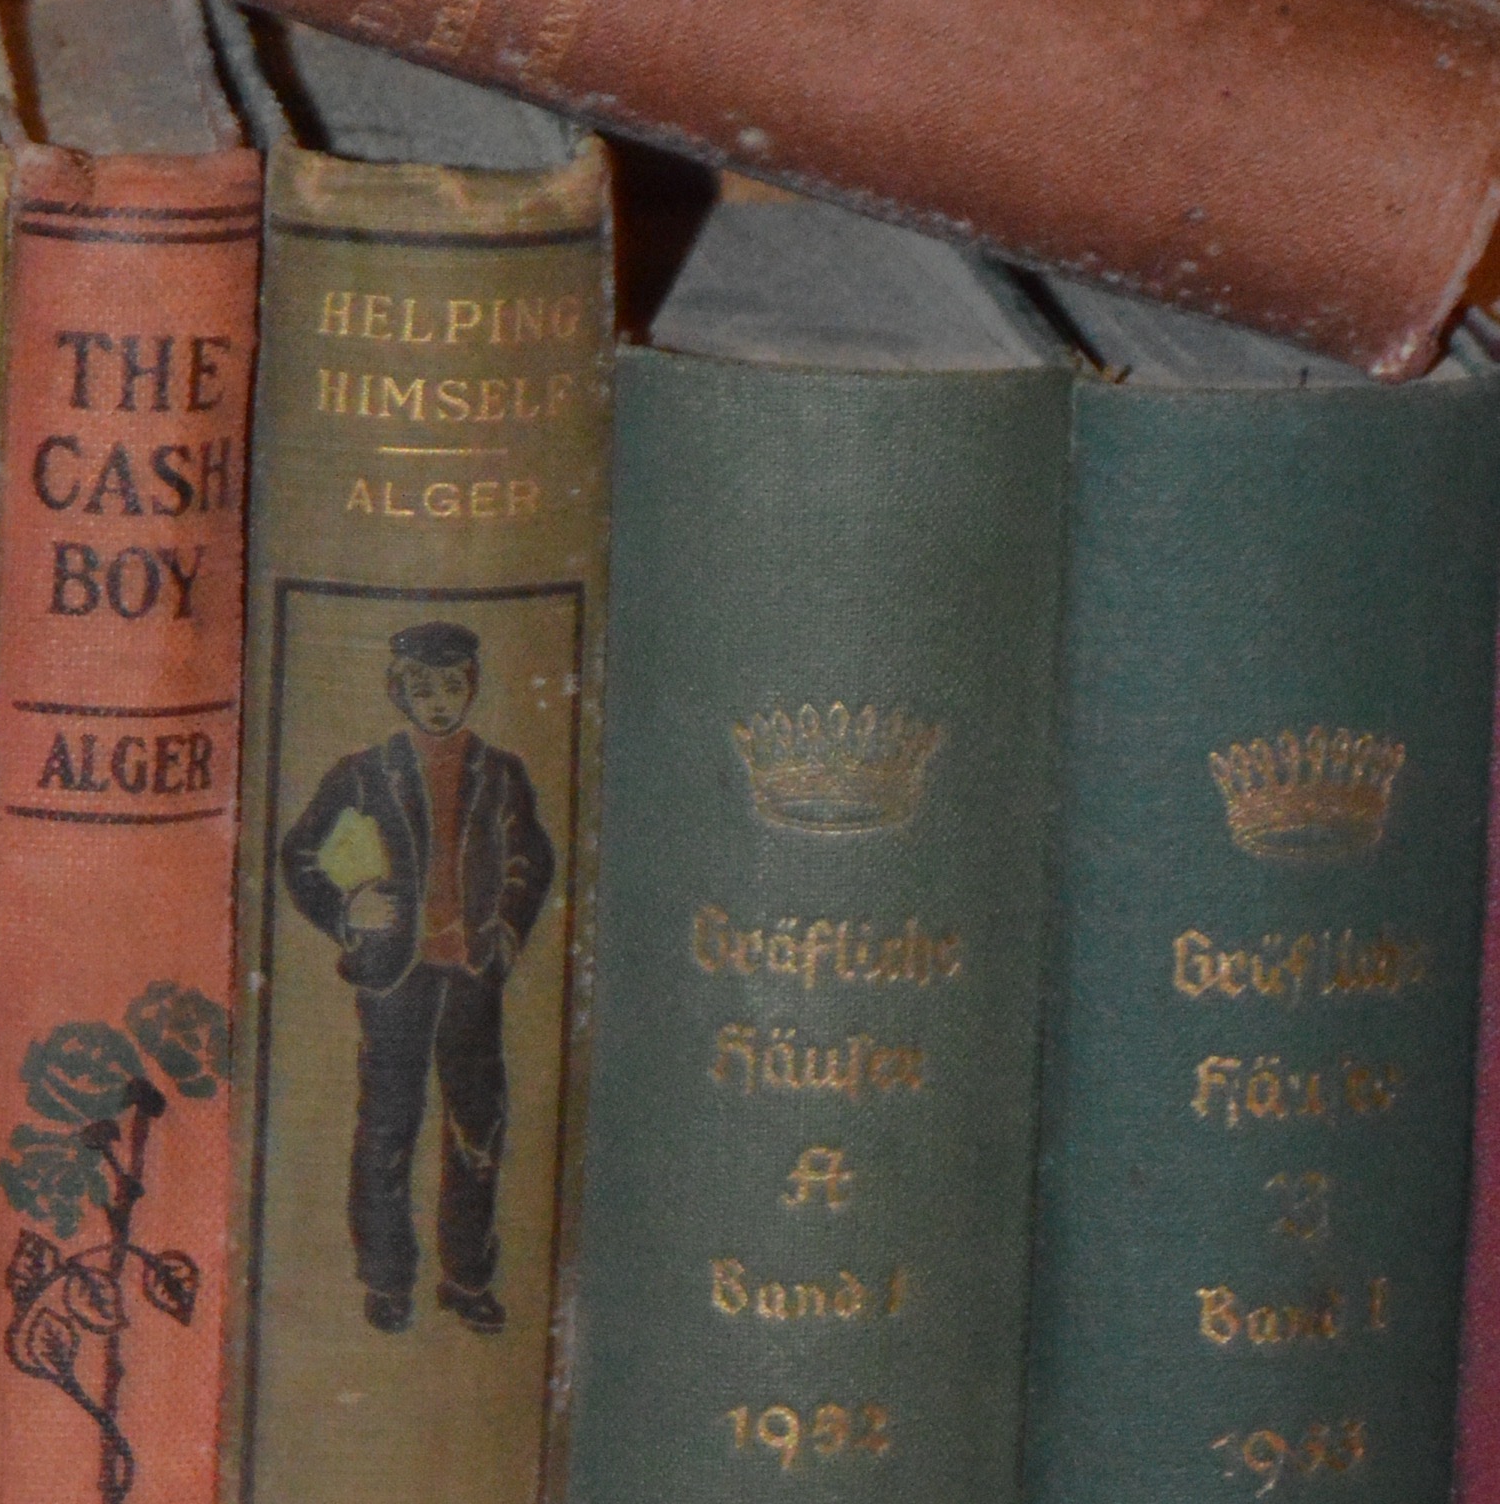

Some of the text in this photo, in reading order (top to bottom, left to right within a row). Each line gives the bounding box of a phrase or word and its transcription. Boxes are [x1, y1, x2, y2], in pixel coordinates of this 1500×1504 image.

[317, 289, 585, 347] HELPING
[55, 330, 233, 414] THE
[317, 367, 579, 425] HIMSELF
[31, 435, 234, 518] CASH
[344, 477, 541, 520] ALGER
[48, 540, 207, 620] BOY
[37, 731, 214, 794] ALGER
[709, 1256, 866, 1322] Band
